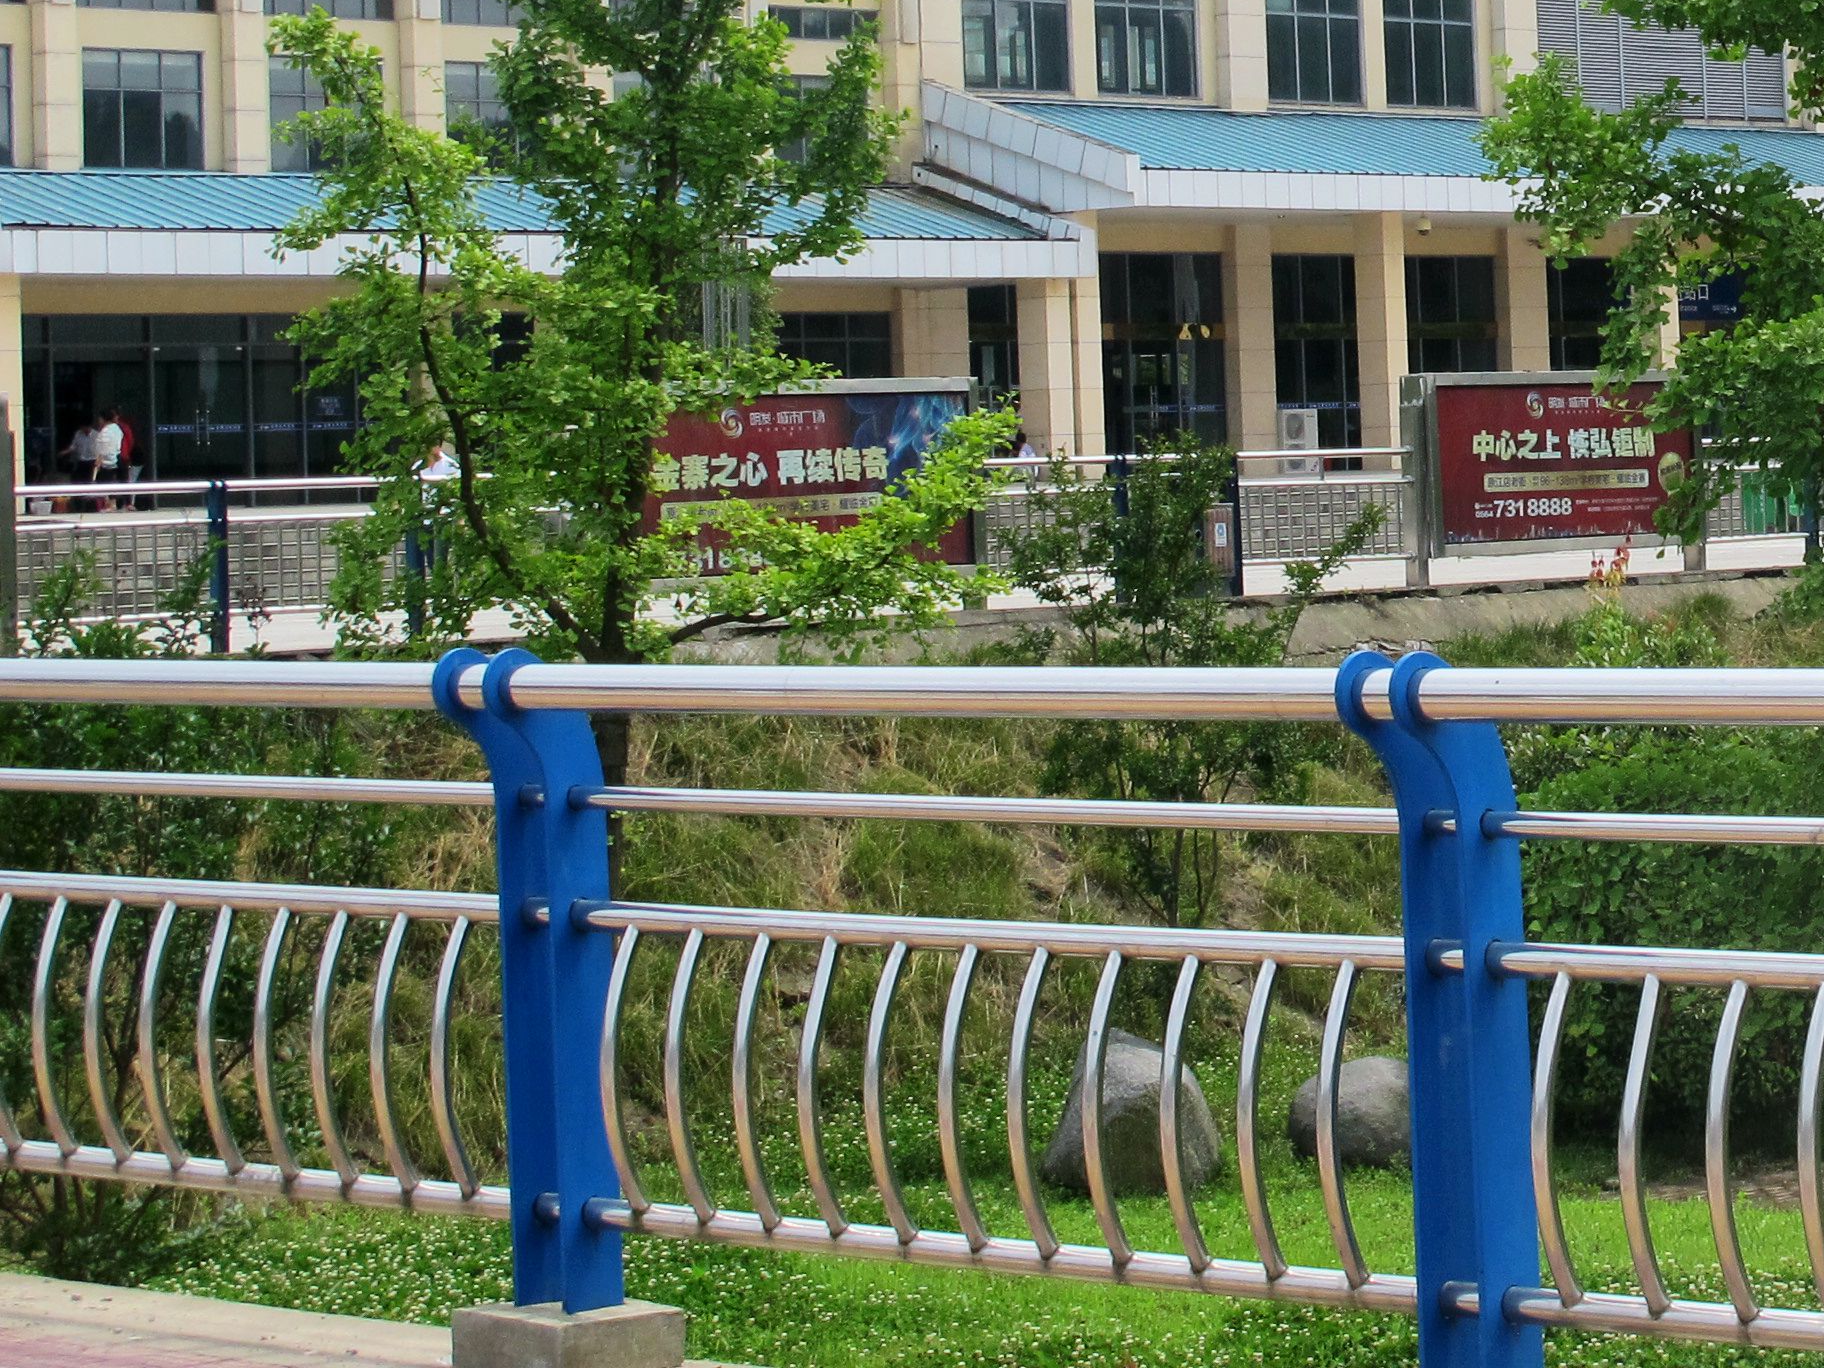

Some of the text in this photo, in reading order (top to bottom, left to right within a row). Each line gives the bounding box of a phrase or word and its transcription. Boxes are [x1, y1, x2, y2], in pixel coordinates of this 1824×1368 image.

[1472, 429, 1562, 462] 中心之上
[651, 446, 890, 491] 金寨之心 再续传奇
[1493, 497, 1573, 518] 7318888
